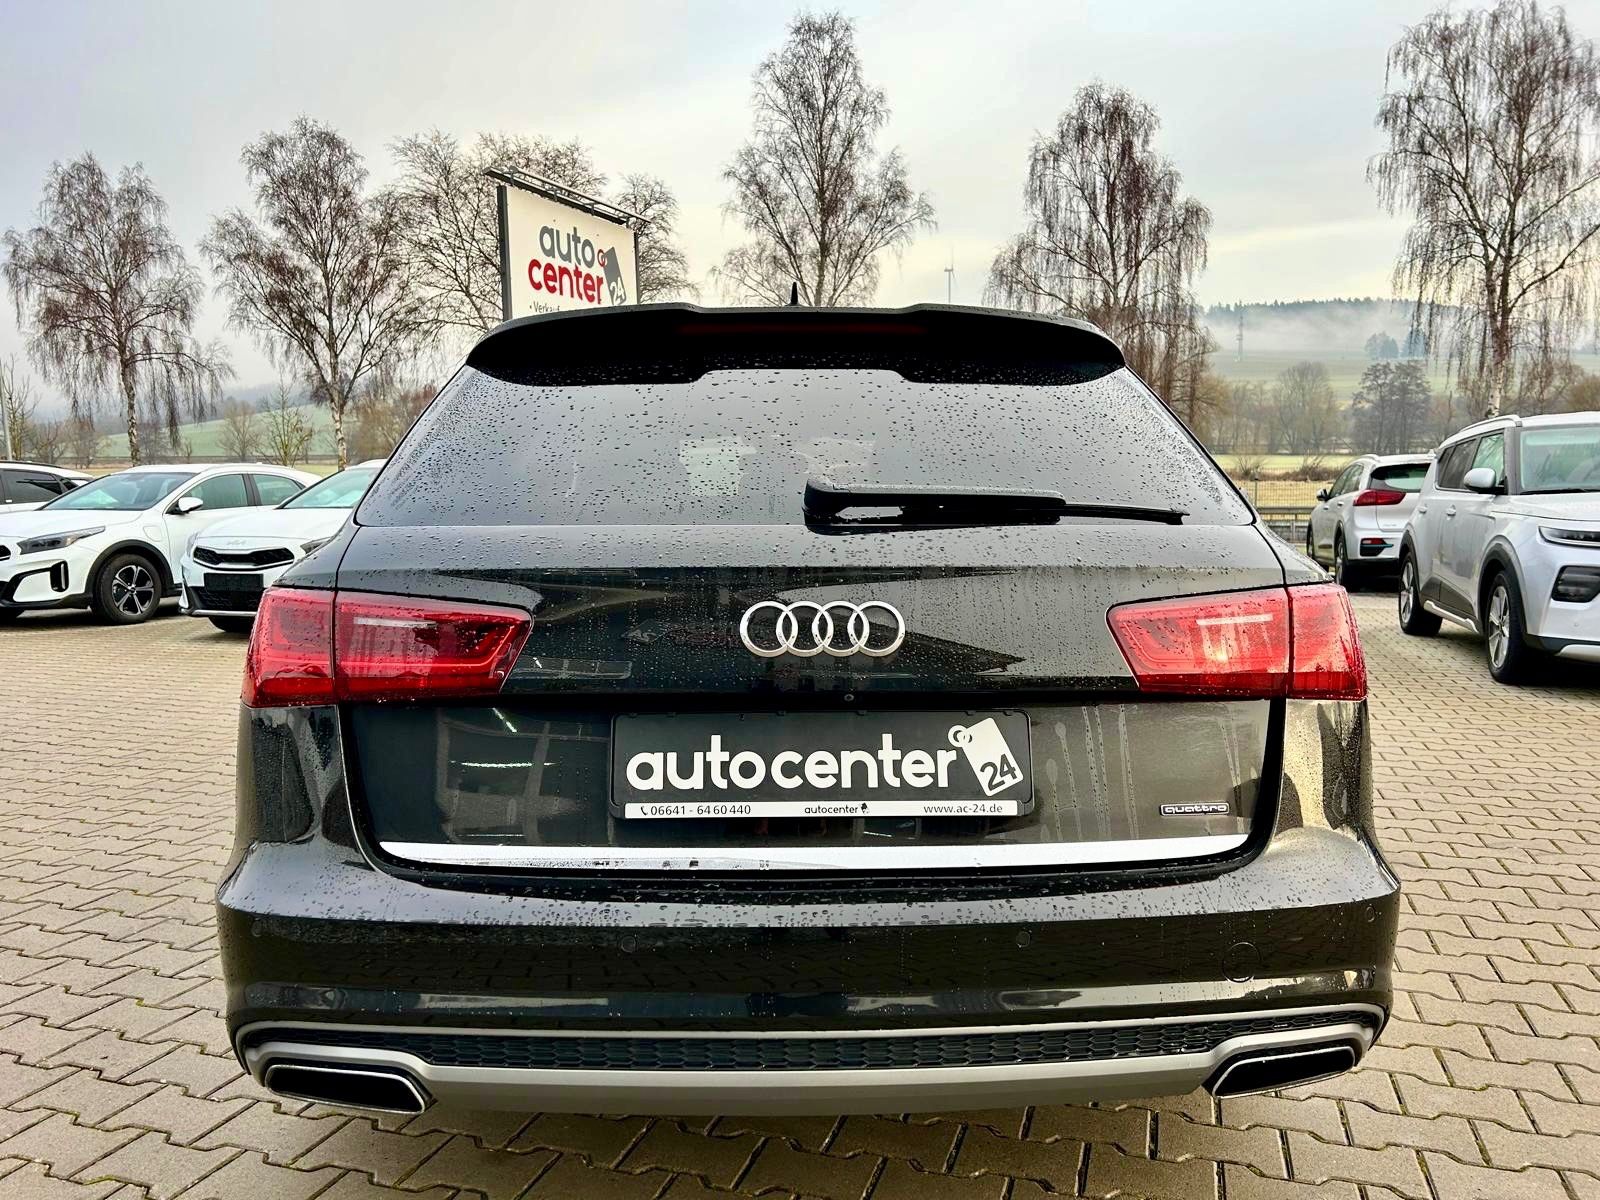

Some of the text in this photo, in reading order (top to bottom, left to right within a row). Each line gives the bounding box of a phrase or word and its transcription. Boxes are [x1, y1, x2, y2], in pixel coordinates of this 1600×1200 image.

[539, 226, 595, 268] auto
[528, 258, 603, 304] center
[610, 276, 625, 304] 24
[626, 734, 1018, 791] autocenter 24
[650, 805, 686, 816] 06641
[804, 804, 858, 815] autocenter
[923, 803, 1003, 814] www.ac-24.de
[1164, 804, 1227, 814] quattro
